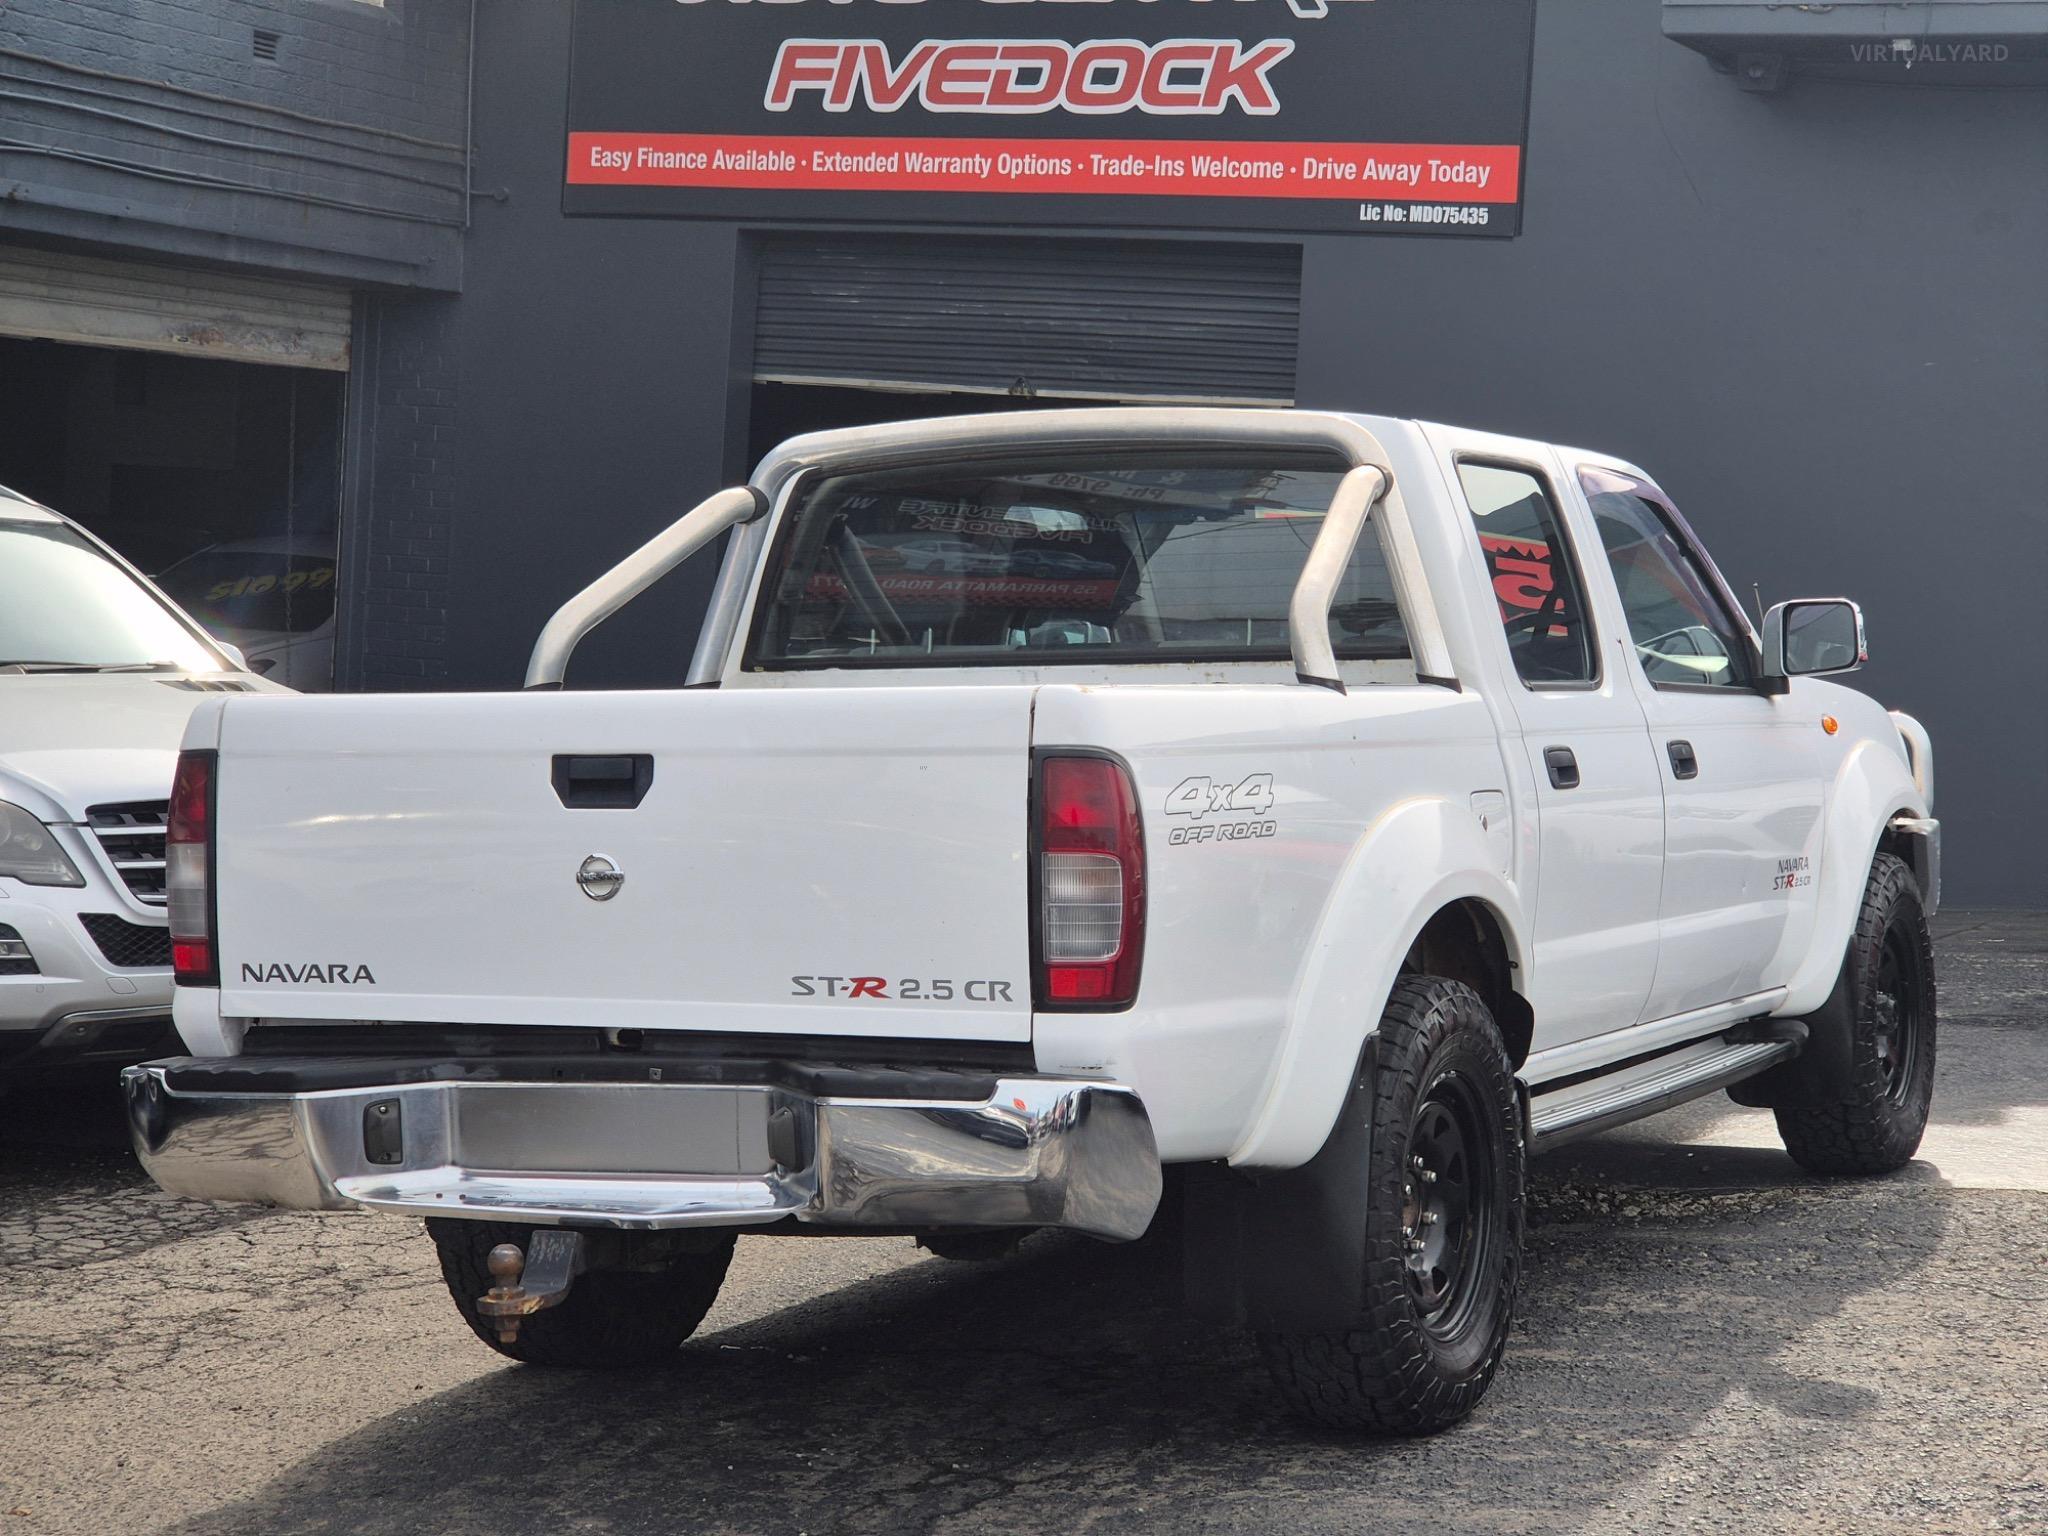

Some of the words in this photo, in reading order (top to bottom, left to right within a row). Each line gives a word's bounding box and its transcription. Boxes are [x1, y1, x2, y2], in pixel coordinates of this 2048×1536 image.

[764, 38, 1295, 115] FIVEDOCK
[590, 146, 632, 172] Easy
[637, 147, 708, 169] Finance
[712, 149, 796, 172] Available
[812, 150, 899, 173] Extended
[904, 152, 992, 178] Warranty
[997, 153, 1072, 179] Options
[1090, 154, 1185, 177] Trade-Ins
[1191, 155, 1284, 179] Welcome
[1303, 157, 1357, 181] Drive
[1362, 158, 1422, 187] Away
[1428, 160, 1491, 188] Today
[1360, 204, 1381, 221] Lic
[1383, 205, 1407, 222] No:
[1409, 205, 1489, 225] MD075435
[1164, 772, 1275, 820] 4x4
[1168, 824, 1215, 846] OFF
[1216, 819, 1277, 842] ROAD
[1777, 856, 1809, 874] NAVARA
[241, 962, 376, 985] NAVARA
[791, 975, 893, 999] ST-R
[898, 978, 954, 1001] 2.5
[964, 980, 1014, 1002] CR
